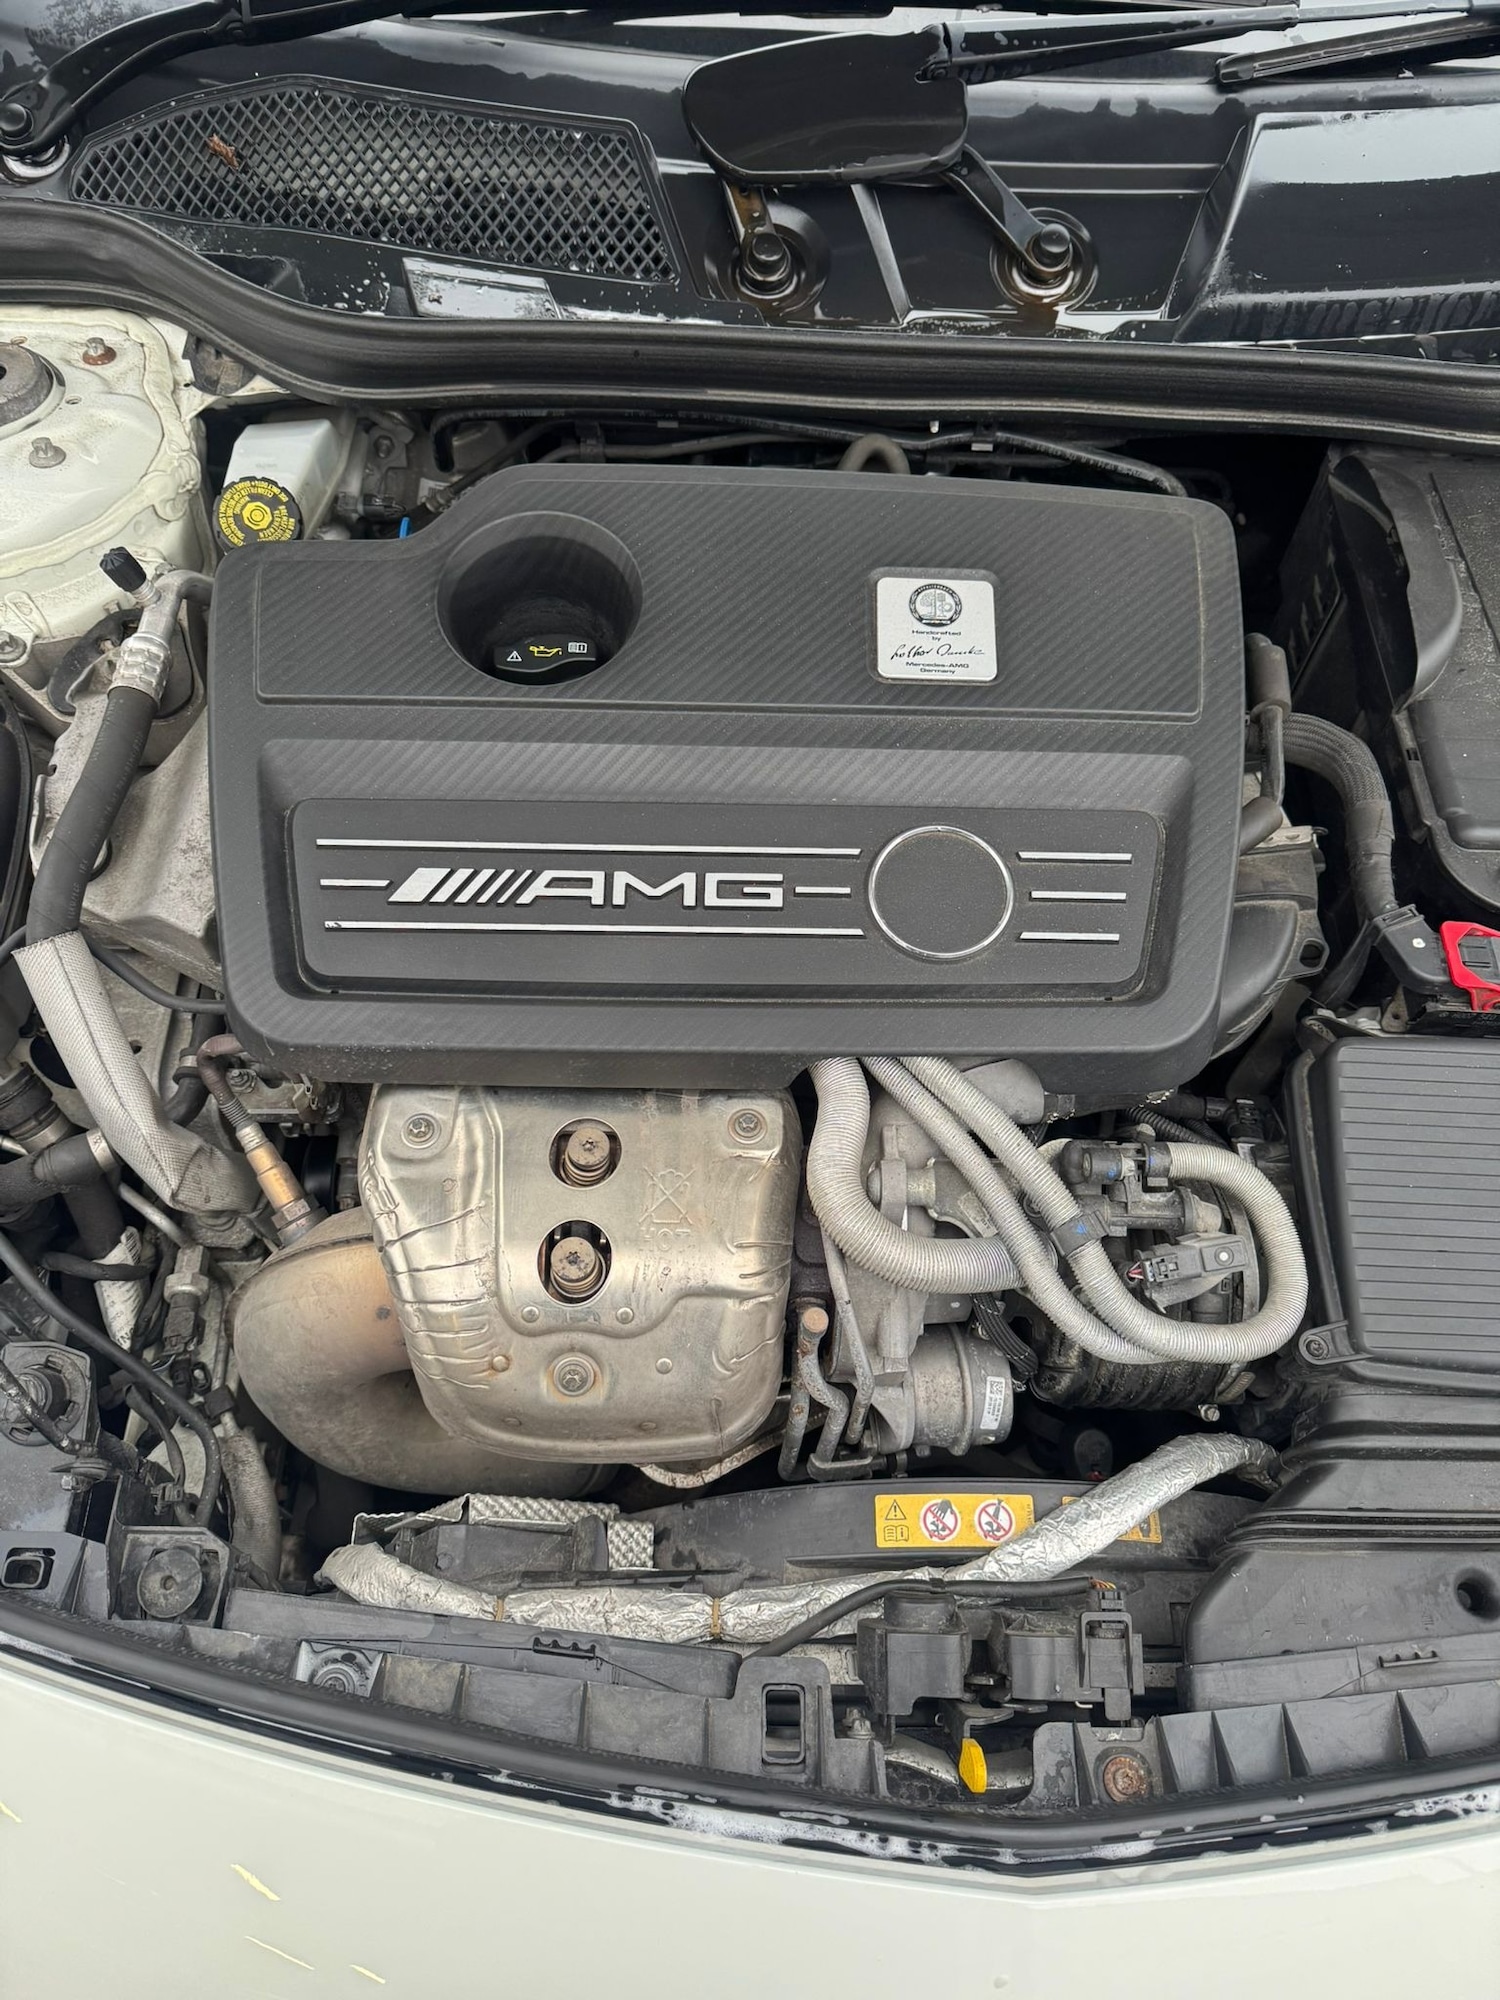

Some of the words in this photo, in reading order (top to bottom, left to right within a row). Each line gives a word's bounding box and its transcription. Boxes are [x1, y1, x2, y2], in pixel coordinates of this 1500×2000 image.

[905, 661, 970, 669] Mercedes-AMG
[515, 868, 784, 908] AMG
[639, 1226, 692, 1252] HOT
